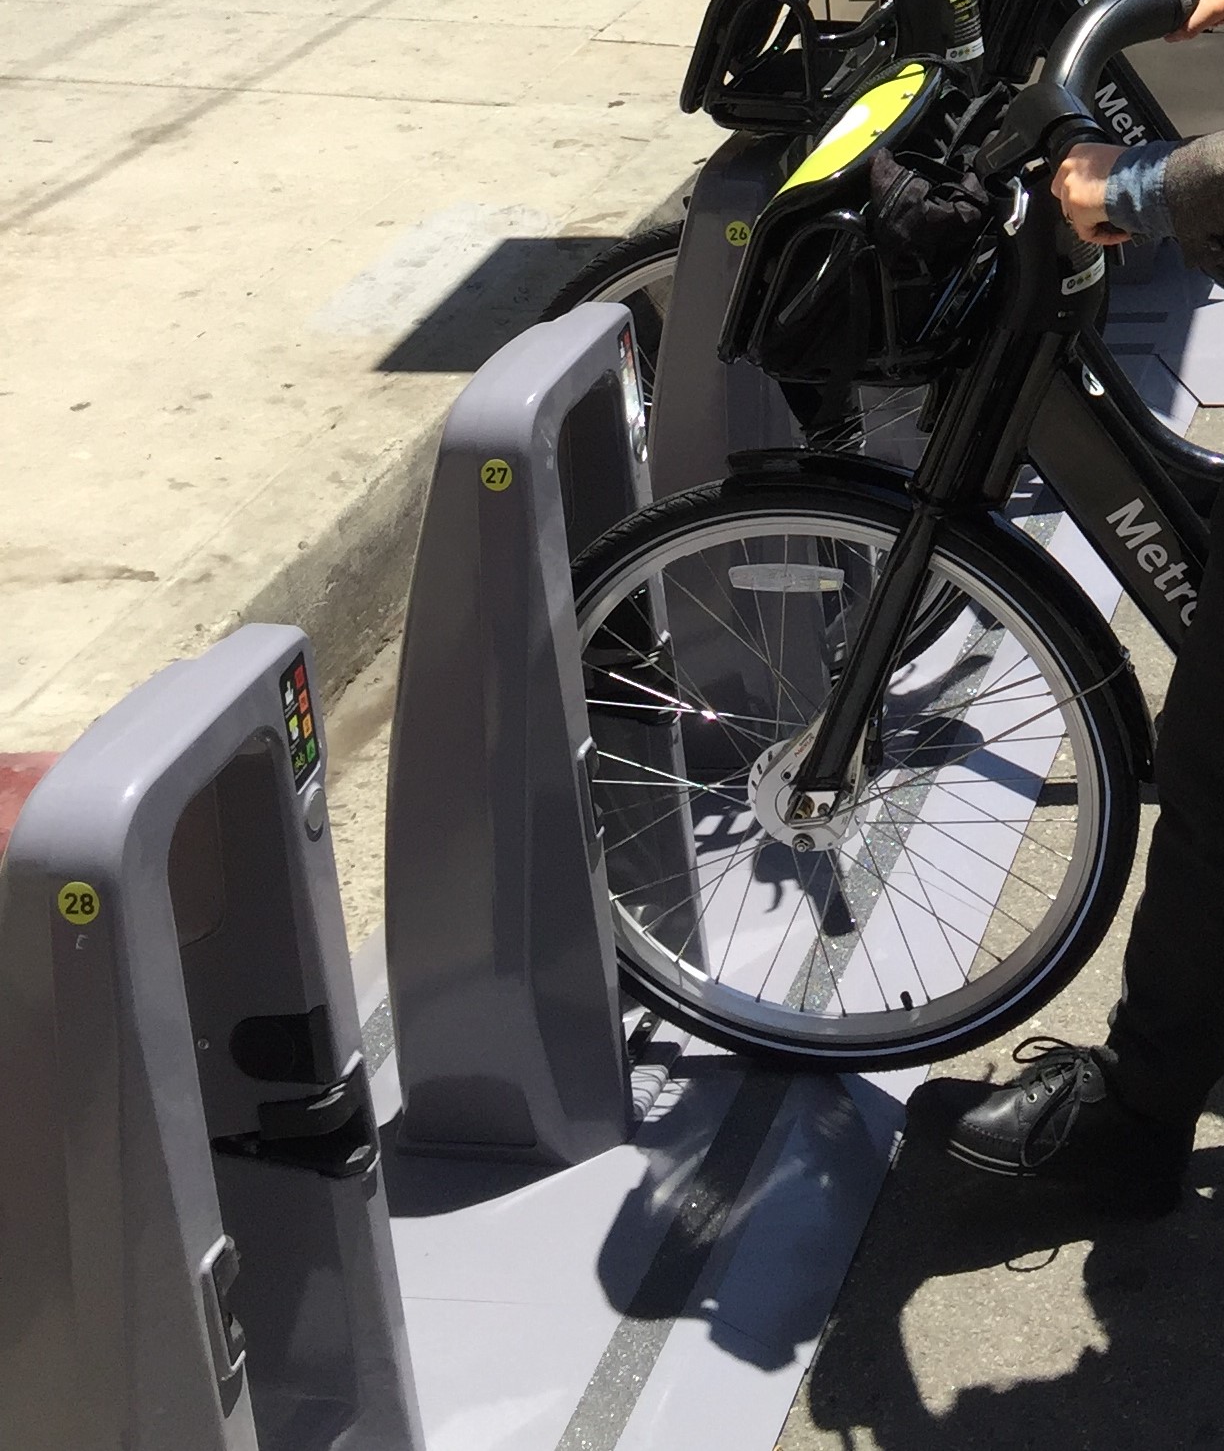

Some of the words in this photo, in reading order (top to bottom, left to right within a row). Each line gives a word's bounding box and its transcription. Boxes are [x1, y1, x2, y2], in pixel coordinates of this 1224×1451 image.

[729, 227, 747, 240] 26
[486, 467, 508, 484] 27
[64, 892, 95, 916] 28
